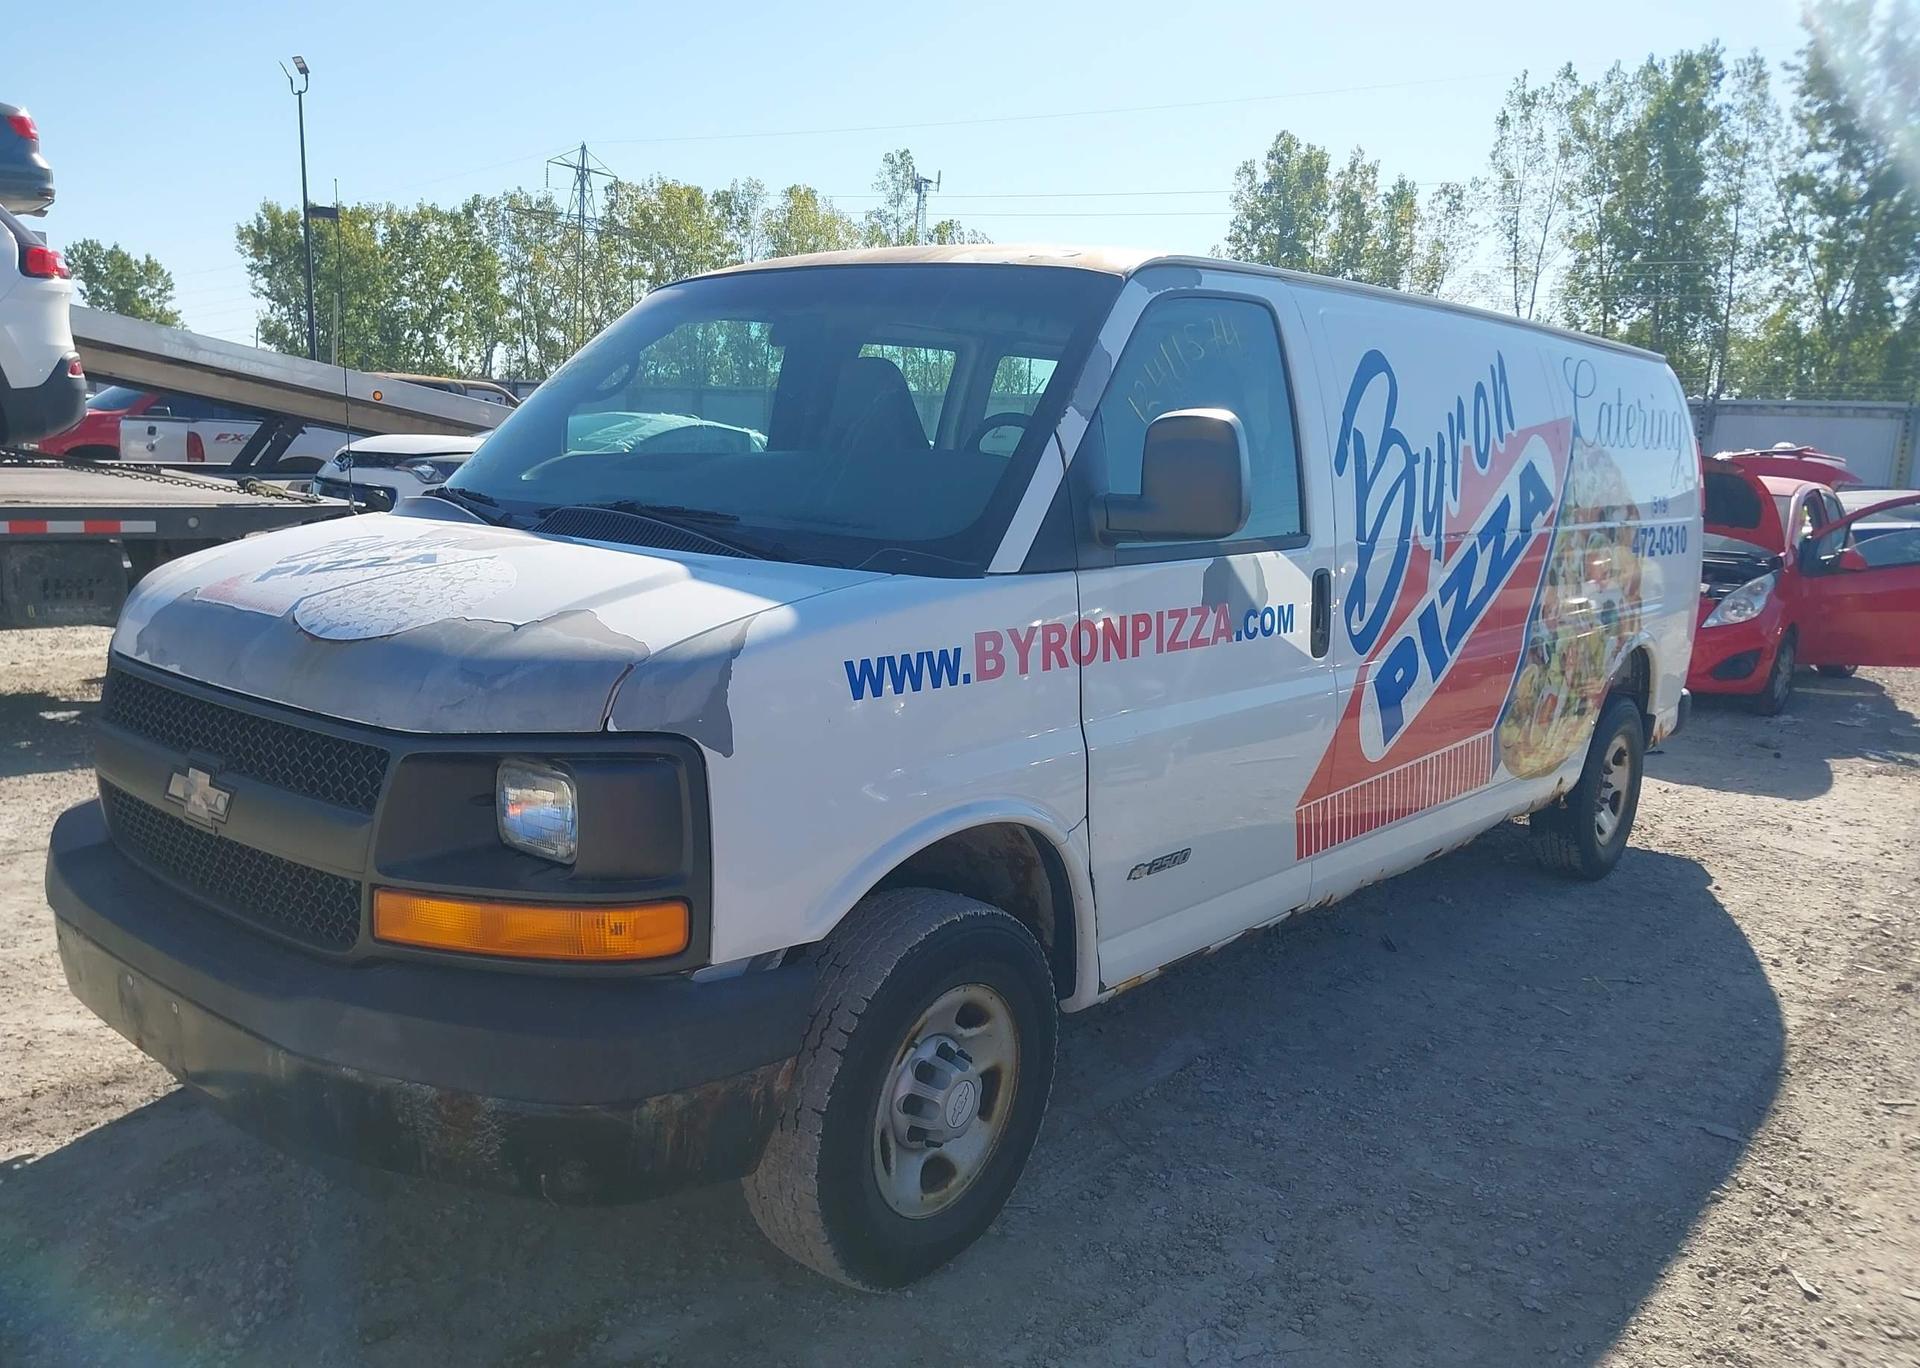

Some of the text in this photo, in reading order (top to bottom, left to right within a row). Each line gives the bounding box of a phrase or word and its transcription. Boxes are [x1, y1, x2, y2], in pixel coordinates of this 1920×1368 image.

[1563, 356, 1682, 489] Catering
[1334, 349, 1515, 656] Byron
[1632, 525, 1687, 558] 472-0310
[844, 603, 1295, 701] WWW.BYRONPIZZA.COM
[1373, 460, 1555, 747] PIZZA
[1148, 848, 1191, 875] 2500
